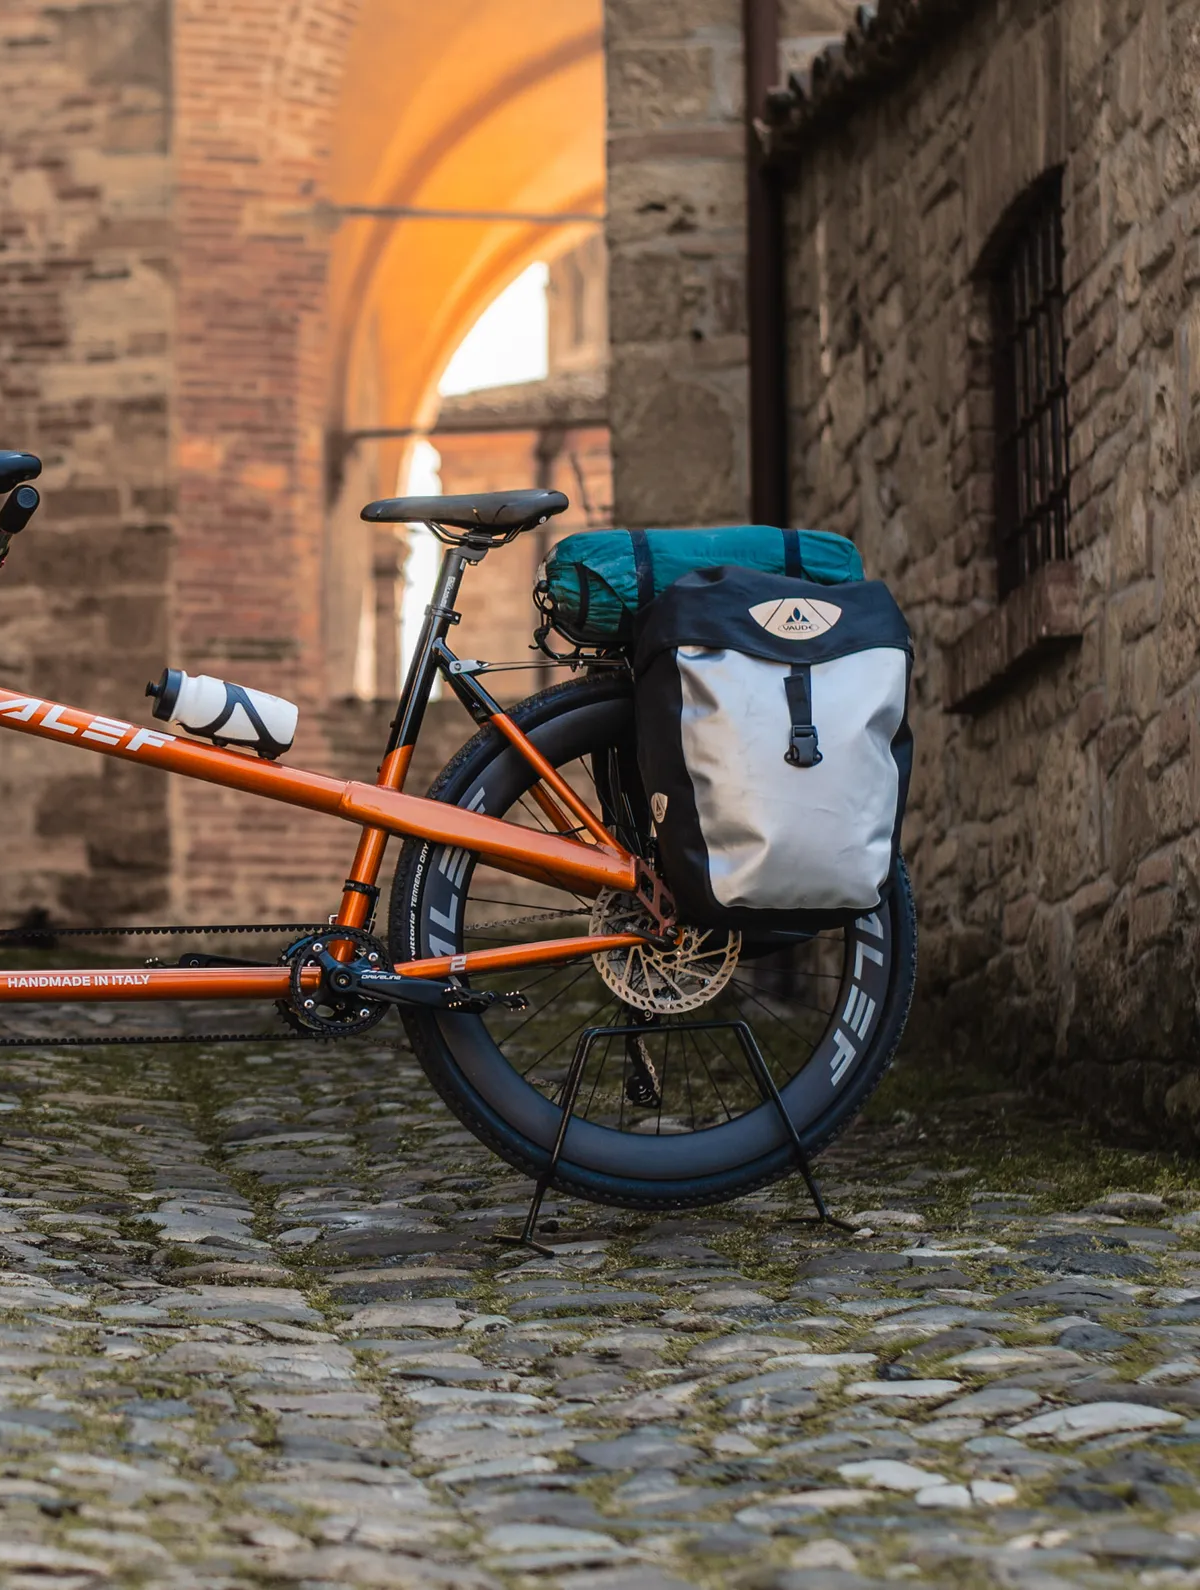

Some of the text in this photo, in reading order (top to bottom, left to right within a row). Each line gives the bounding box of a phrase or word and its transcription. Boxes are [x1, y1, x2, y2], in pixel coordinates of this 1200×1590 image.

[410, 864, 424, 907] TERRENO
[7, 974, 150, 988] HANDMADE IN ITALY
